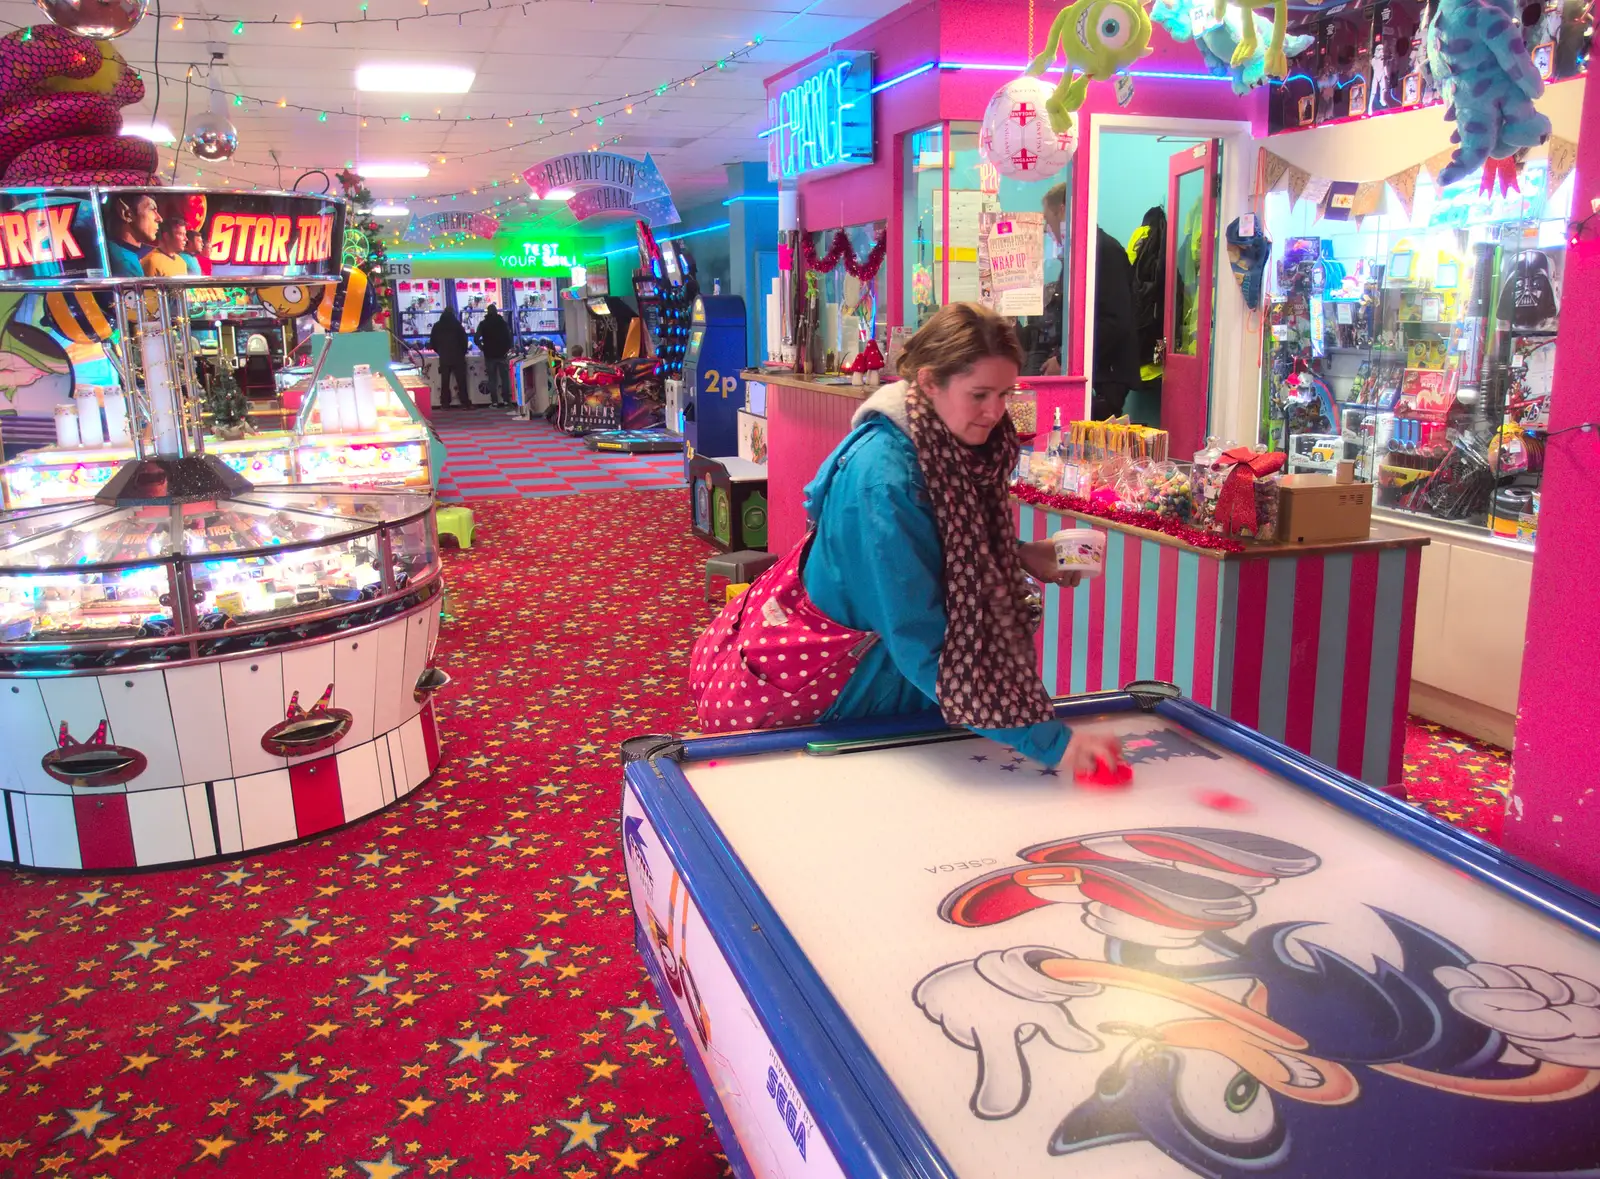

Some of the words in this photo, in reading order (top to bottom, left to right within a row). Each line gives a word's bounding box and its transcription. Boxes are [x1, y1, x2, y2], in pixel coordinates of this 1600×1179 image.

[545, 154, 636, 189] REDEMPTION
[597, 187, 639, 211] CHANG
[208, 213, 292, 264] STAR
[296, 213, 334, 263] TREK
[523, 243, 559, 256] TEST
[500, 255, 537, 267] YOUR
[991, 255, 1014, 272] WRAP
[1015, 252, 1027, 268] UP
[704, 369, 737, 399] 2p
[571, 404, 615, 418] ALIENS
[768, 1047, 802, 1111] POWERED
[802, 1110, 814, 1131] BY
[766, 1064, 807, 1163] SEGA
